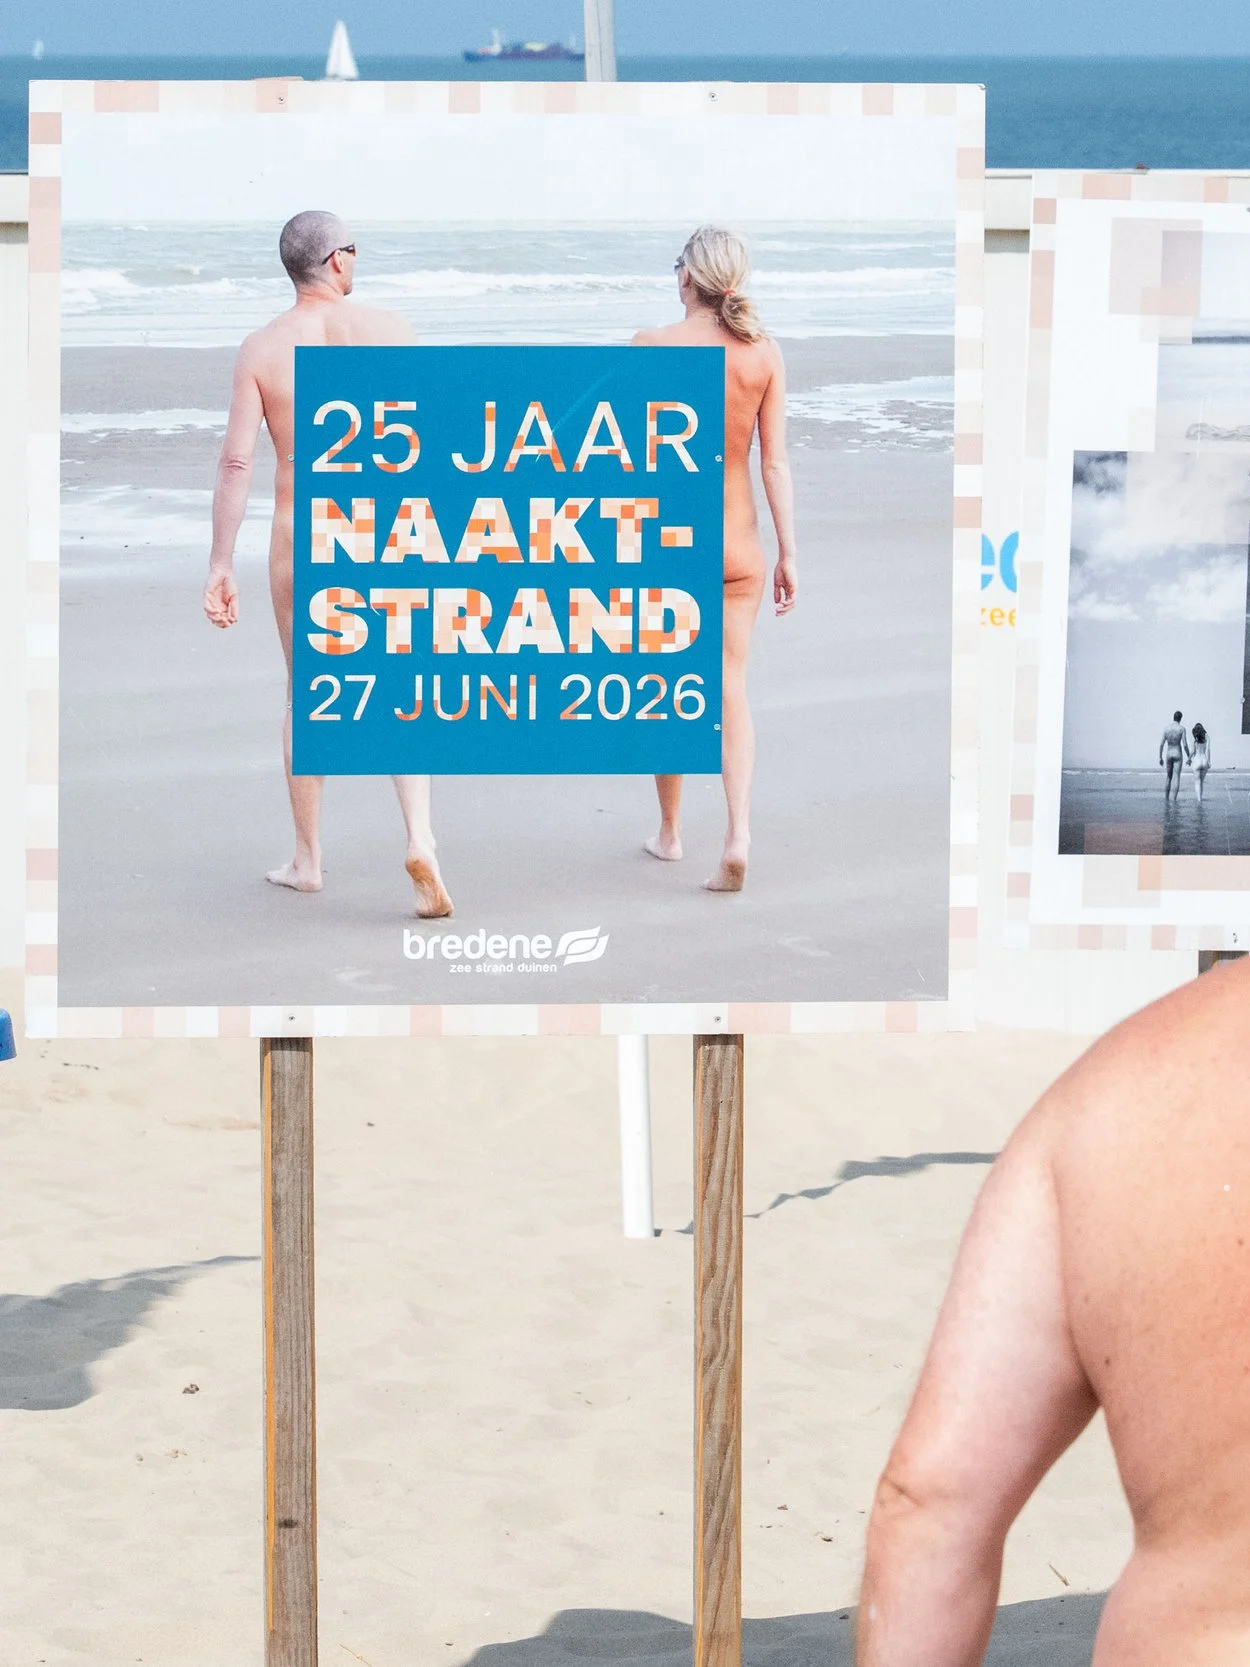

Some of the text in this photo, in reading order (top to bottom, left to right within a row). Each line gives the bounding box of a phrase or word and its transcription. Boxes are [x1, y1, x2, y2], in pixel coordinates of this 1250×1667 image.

[312, 400, 700, 474] 25 JAAR
[310, 497, 694, 564] NAAKT-
[307, 586, 702, 655] STRAND
[308, 672, 706, 722] 27 JUNI 2026
[402, 928, 552, 961] bredene
[449, 962, 558, 973] zee strand duinen
